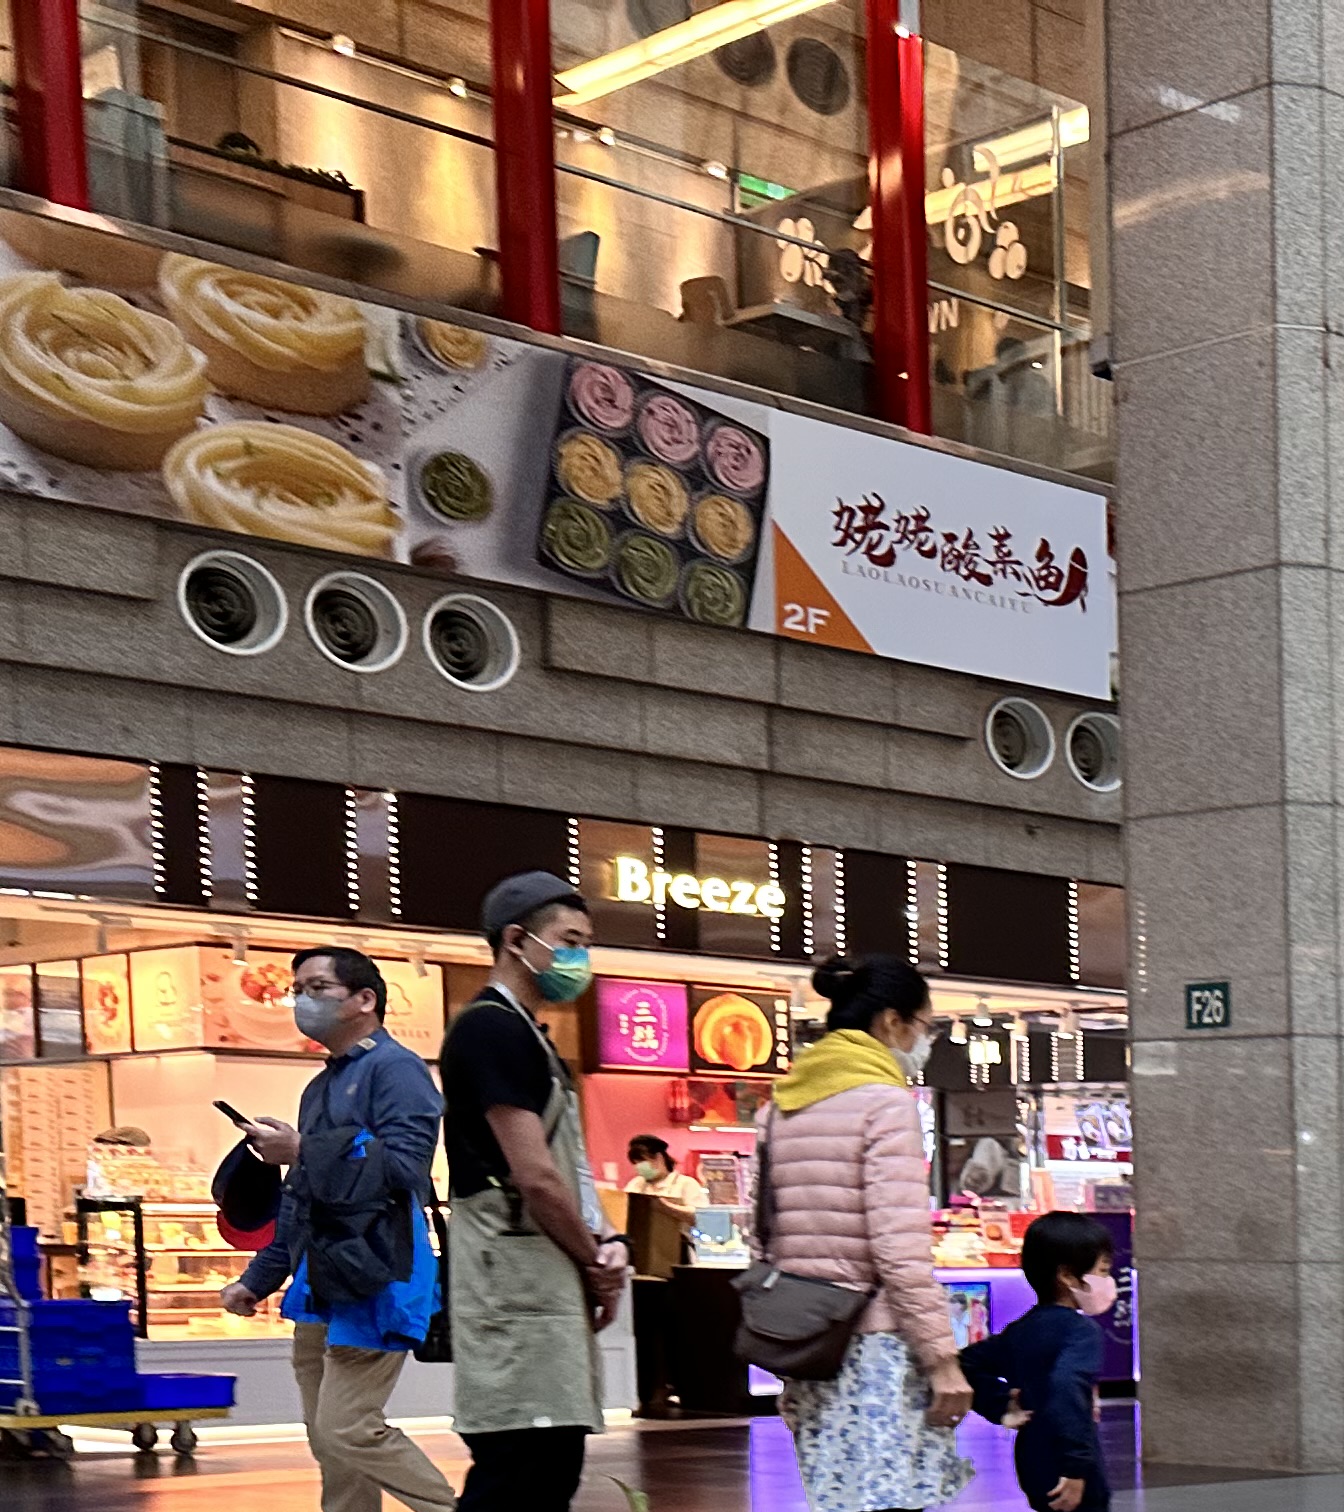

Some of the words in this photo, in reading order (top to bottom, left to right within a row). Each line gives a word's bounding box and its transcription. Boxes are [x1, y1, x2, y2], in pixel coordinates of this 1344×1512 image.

[783, 602, 831, 634] 2F
[616, 856, 786, 918] Breeze
[1191, 989, 1225, 1024] F26
